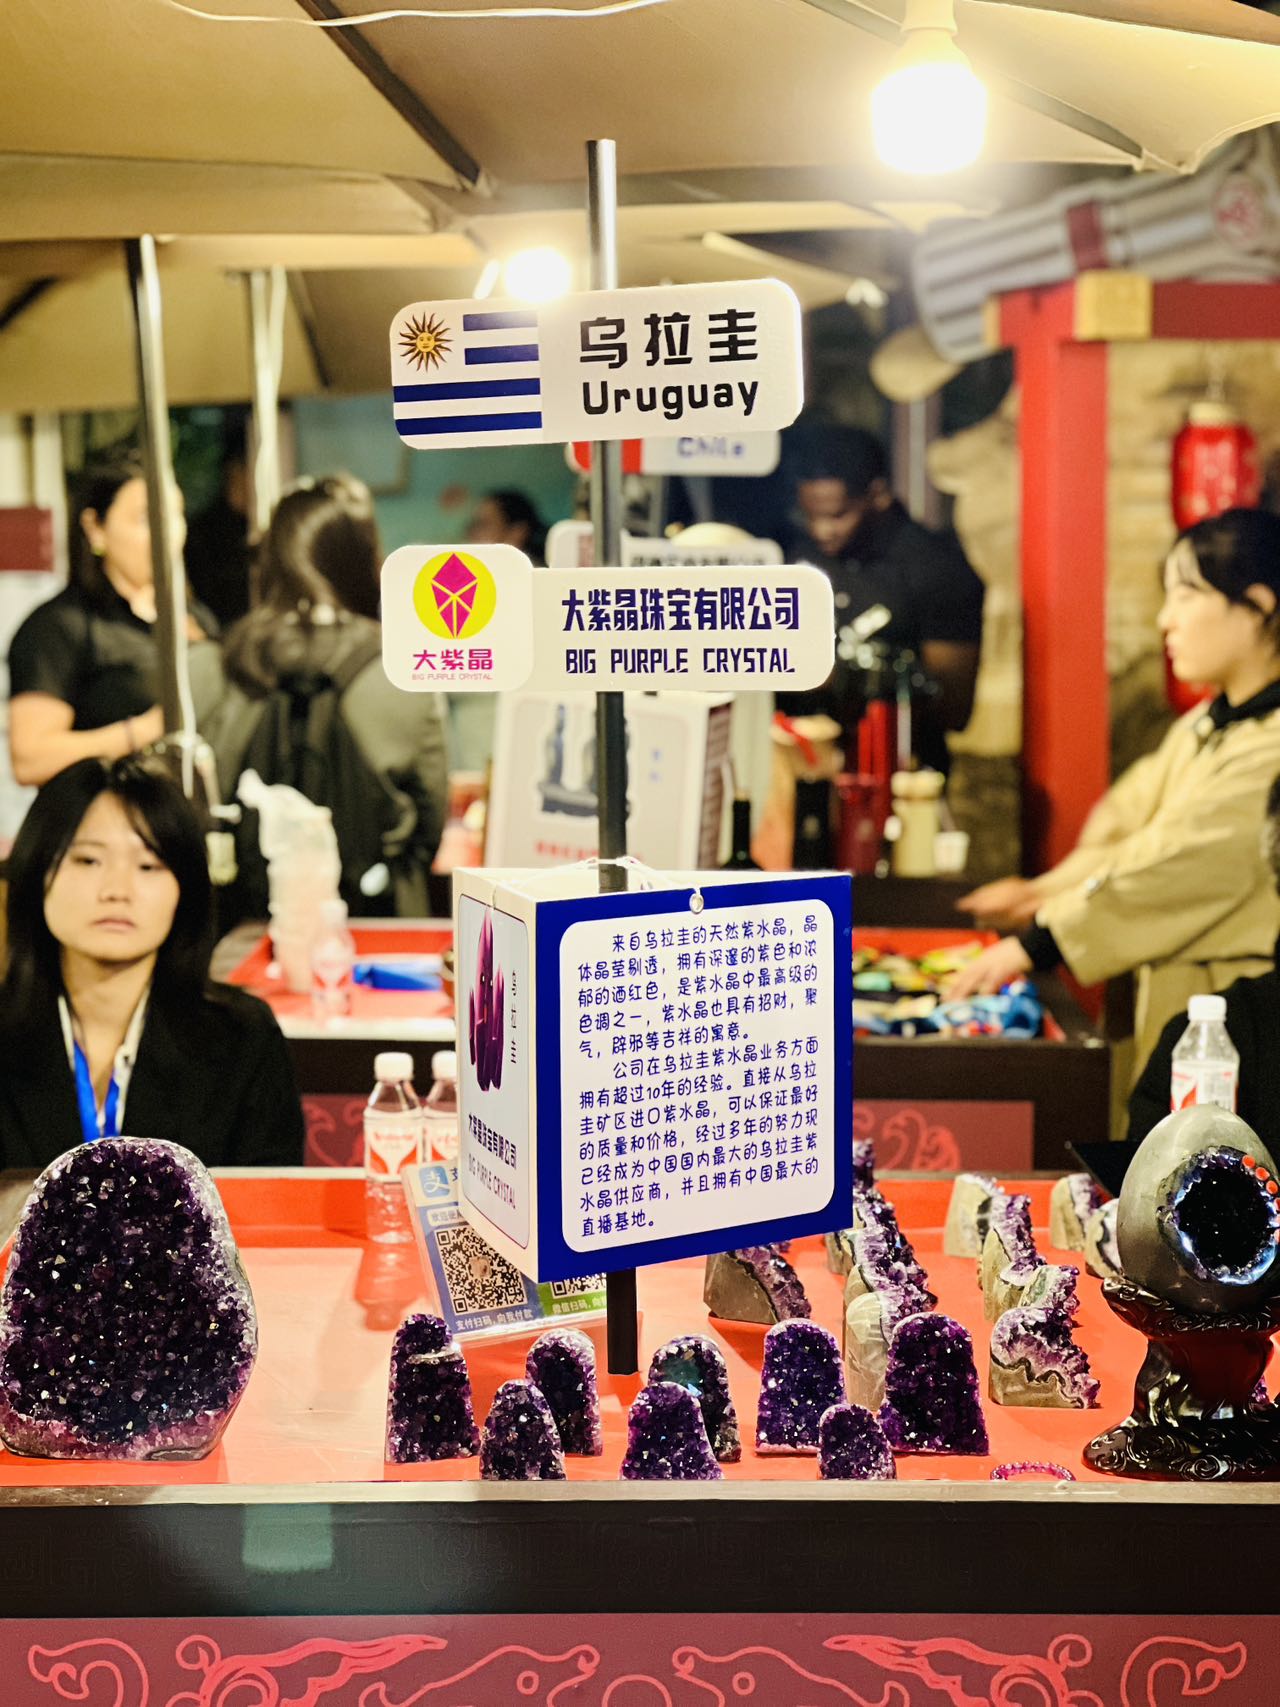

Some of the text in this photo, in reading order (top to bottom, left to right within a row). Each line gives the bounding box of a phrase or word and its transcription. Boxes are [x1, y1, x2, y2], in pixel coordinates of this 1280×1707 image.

[579, 308, 758, 369] 乌拉圭
[582, 379, 759, 420] Uruguay
[561, 587, 800, 632] 大紫晶珠宝有限公司
[413, 648, 493, 670] 大紫晶
[566, 648, 795, 674] BIG PURPLE CRYSTAL
[612, 914, 818, 953] 来自乌拉圭的天然紫水晶，晶
[578, 939, 818, 982] 体晶莹剔透，拥有深邃的紫色和浓
[578, 964, 818, 1008] 郁的酒红色，是紫水晶中最高级的
[579, 987, 818, 1034] 色调之一，紫水晶也具有招财，聚
[579, 1021, 749, 1059] 气，辟邪等吉祥的寓意。
[613, 1036, 819, 1080] 公司在乌拉圭紫水晶业务方面
[580, 1060, 818, 1110] 拥有超过10年的经验。直接从乌拉
[580, 1084, 819, 1136] 圭矿区进口紫水晶，可以保证最好
[580, 1108, 818, 1161] 的质量和价格，经过多年的努力现
[581, 1132, 819, 1185] 已经成为中国国内最大的乌拉圭紫
[493, 1175, 516, 1210] CRYSTAL
[580, 1156, 819, 1212] 水晶供应商，并且拥有中国最大的
[582, 1209, 655, 1237] 直播基地。
